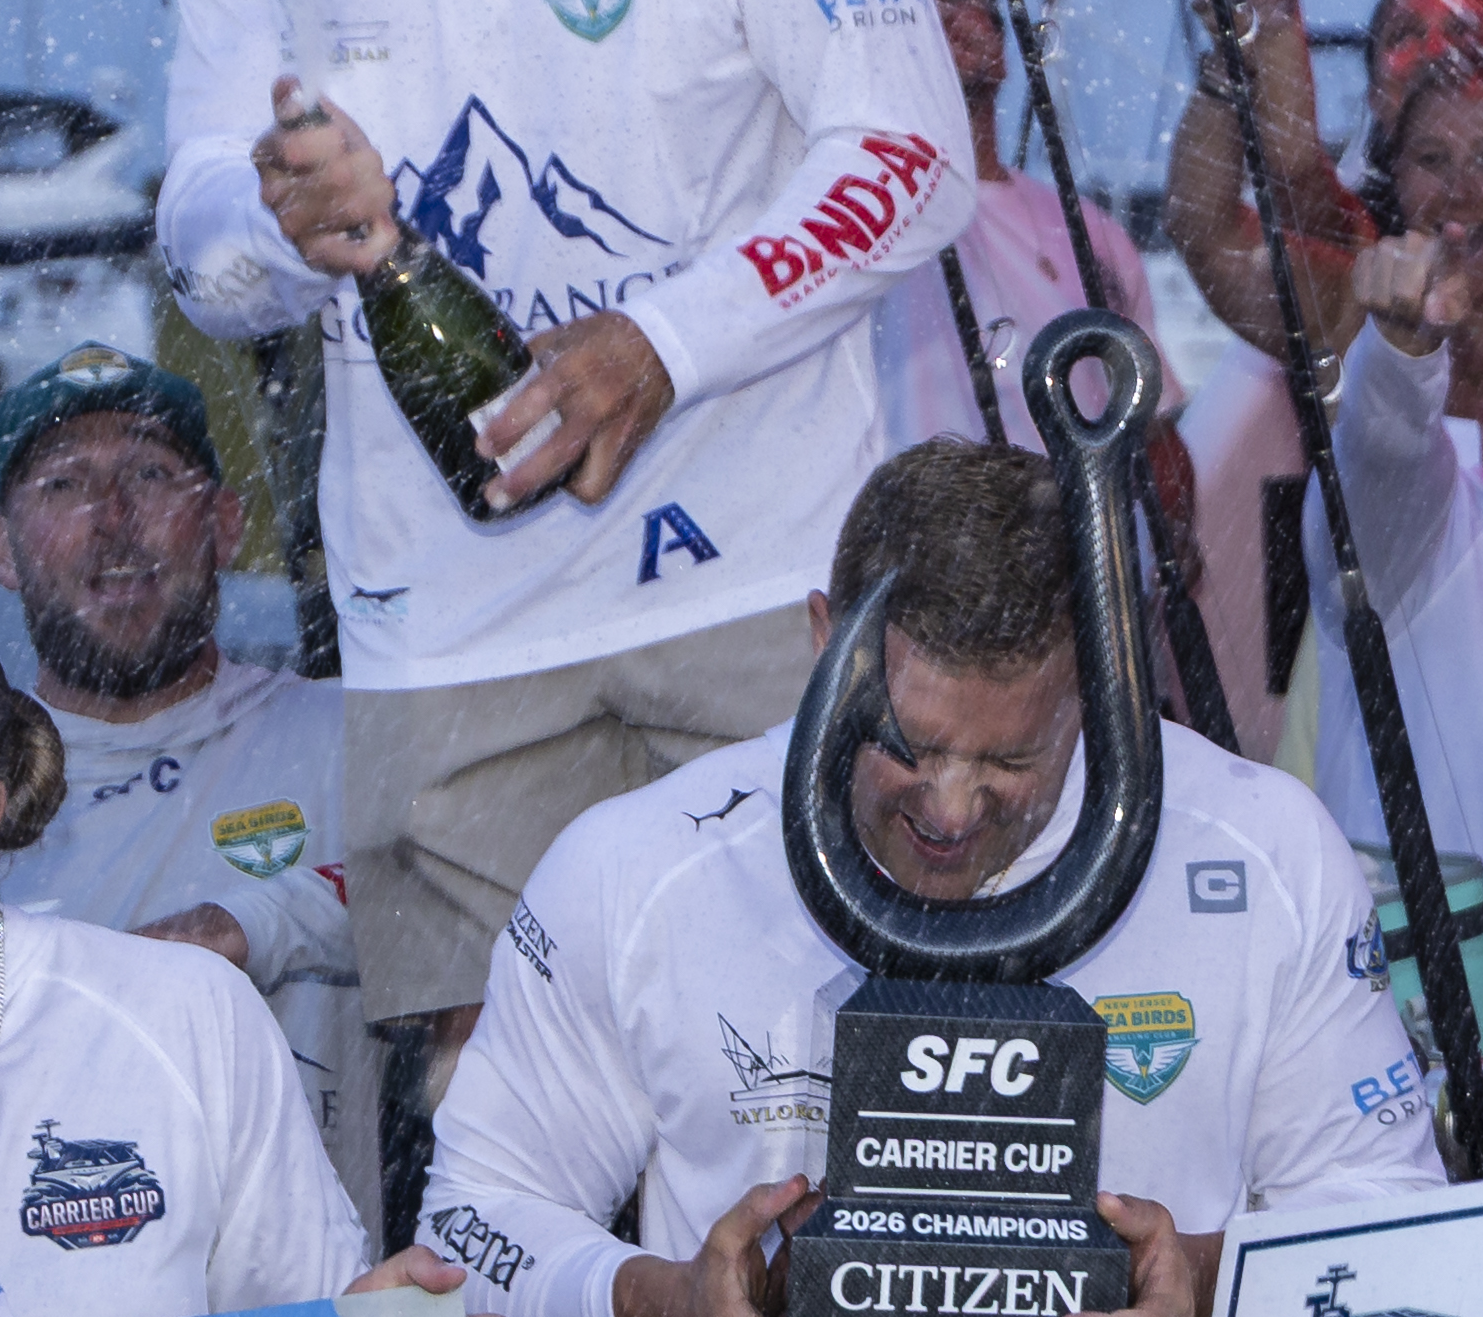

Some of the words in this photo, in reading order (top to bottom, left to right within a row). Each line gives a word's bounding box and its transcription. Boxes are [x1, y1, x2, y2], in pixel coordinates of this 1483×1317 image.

[1103, 1011, 1127, 1028] EA
[1131, 1009, 1186, 1026] BIRDS
[1104, 999, 1130, 1011] NEW
[1133, 997, 1173, 1009] JERSEY
[900, 1035, 1040, 1096] SFC
[856, 1137, 997, 1171] CARRIER
[1004, 1142, 1073, 1173] CUP
[26, 1195, 116, 1230] CARRIER
[120, 1189, 160, 1217] CUP
[833, 1209, 906, 1233] 2026
[912, 1212, 1088, 1241] CHAMPIONS
[830, 1261, 1089, 1317] CITIZEN
